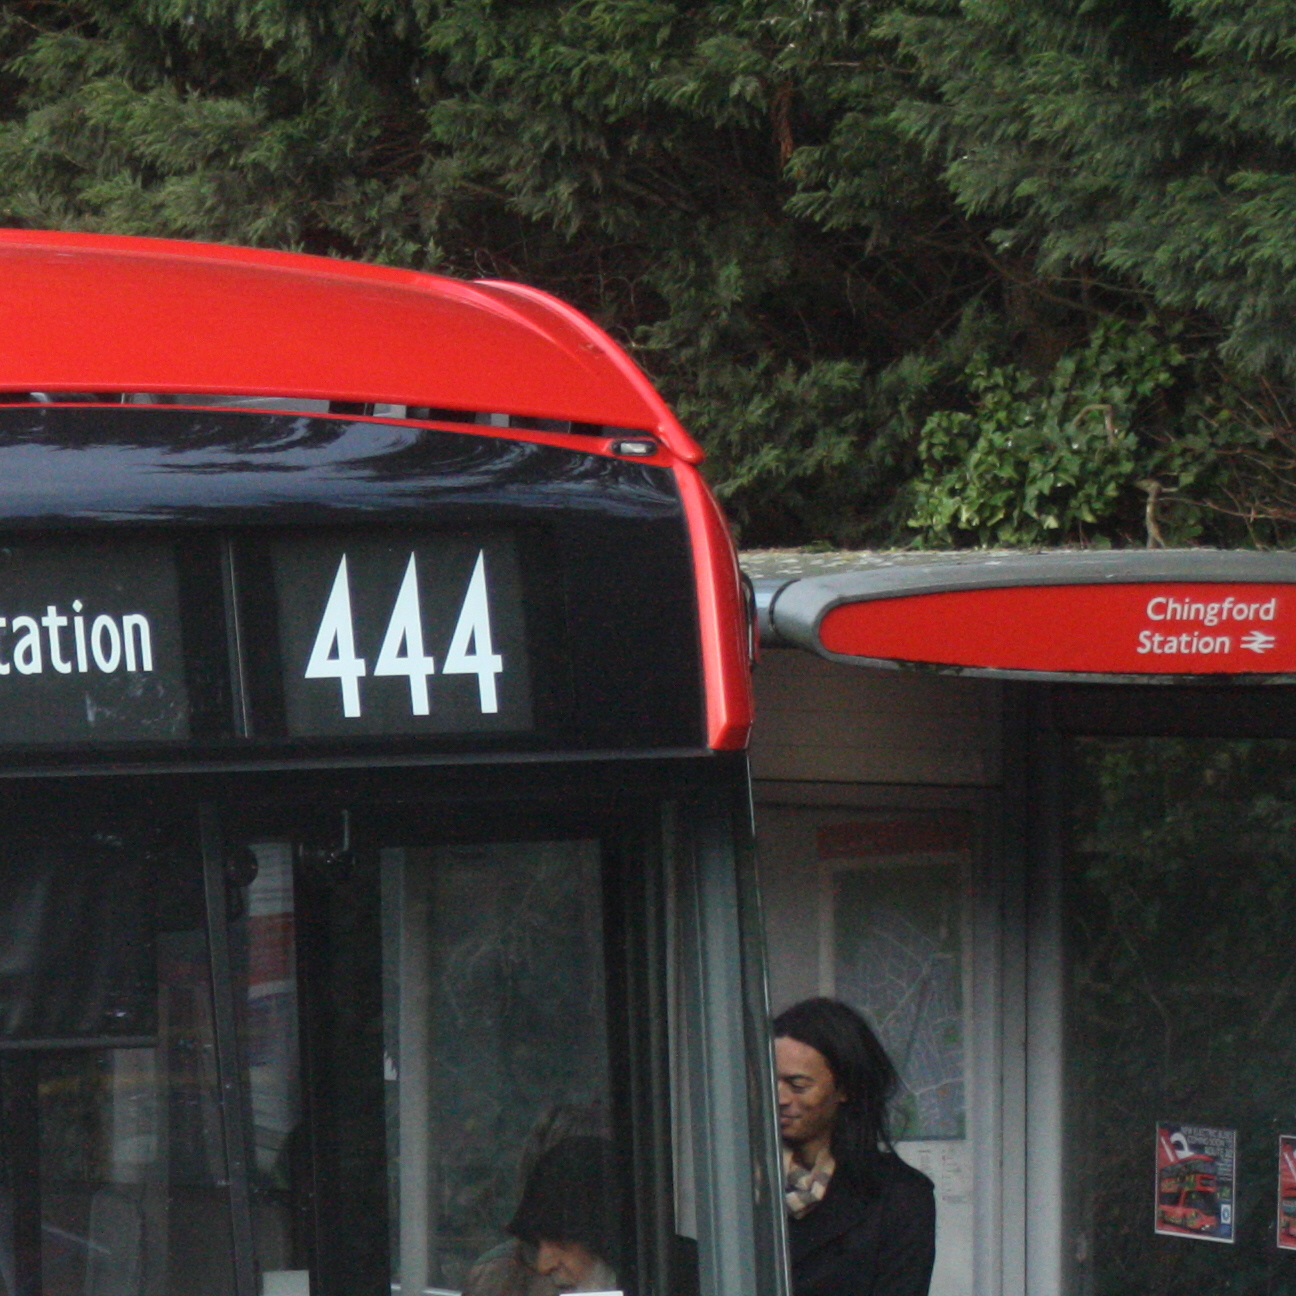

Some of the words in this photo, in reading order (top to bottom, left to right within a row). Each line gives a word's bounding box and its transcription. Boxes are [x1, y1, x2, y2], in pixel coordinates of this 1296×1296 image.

[1146, 596, 1277, 627] Chingford
[303, 547, 504, 719] 444
[1136, 630, 1231, 654] Station
